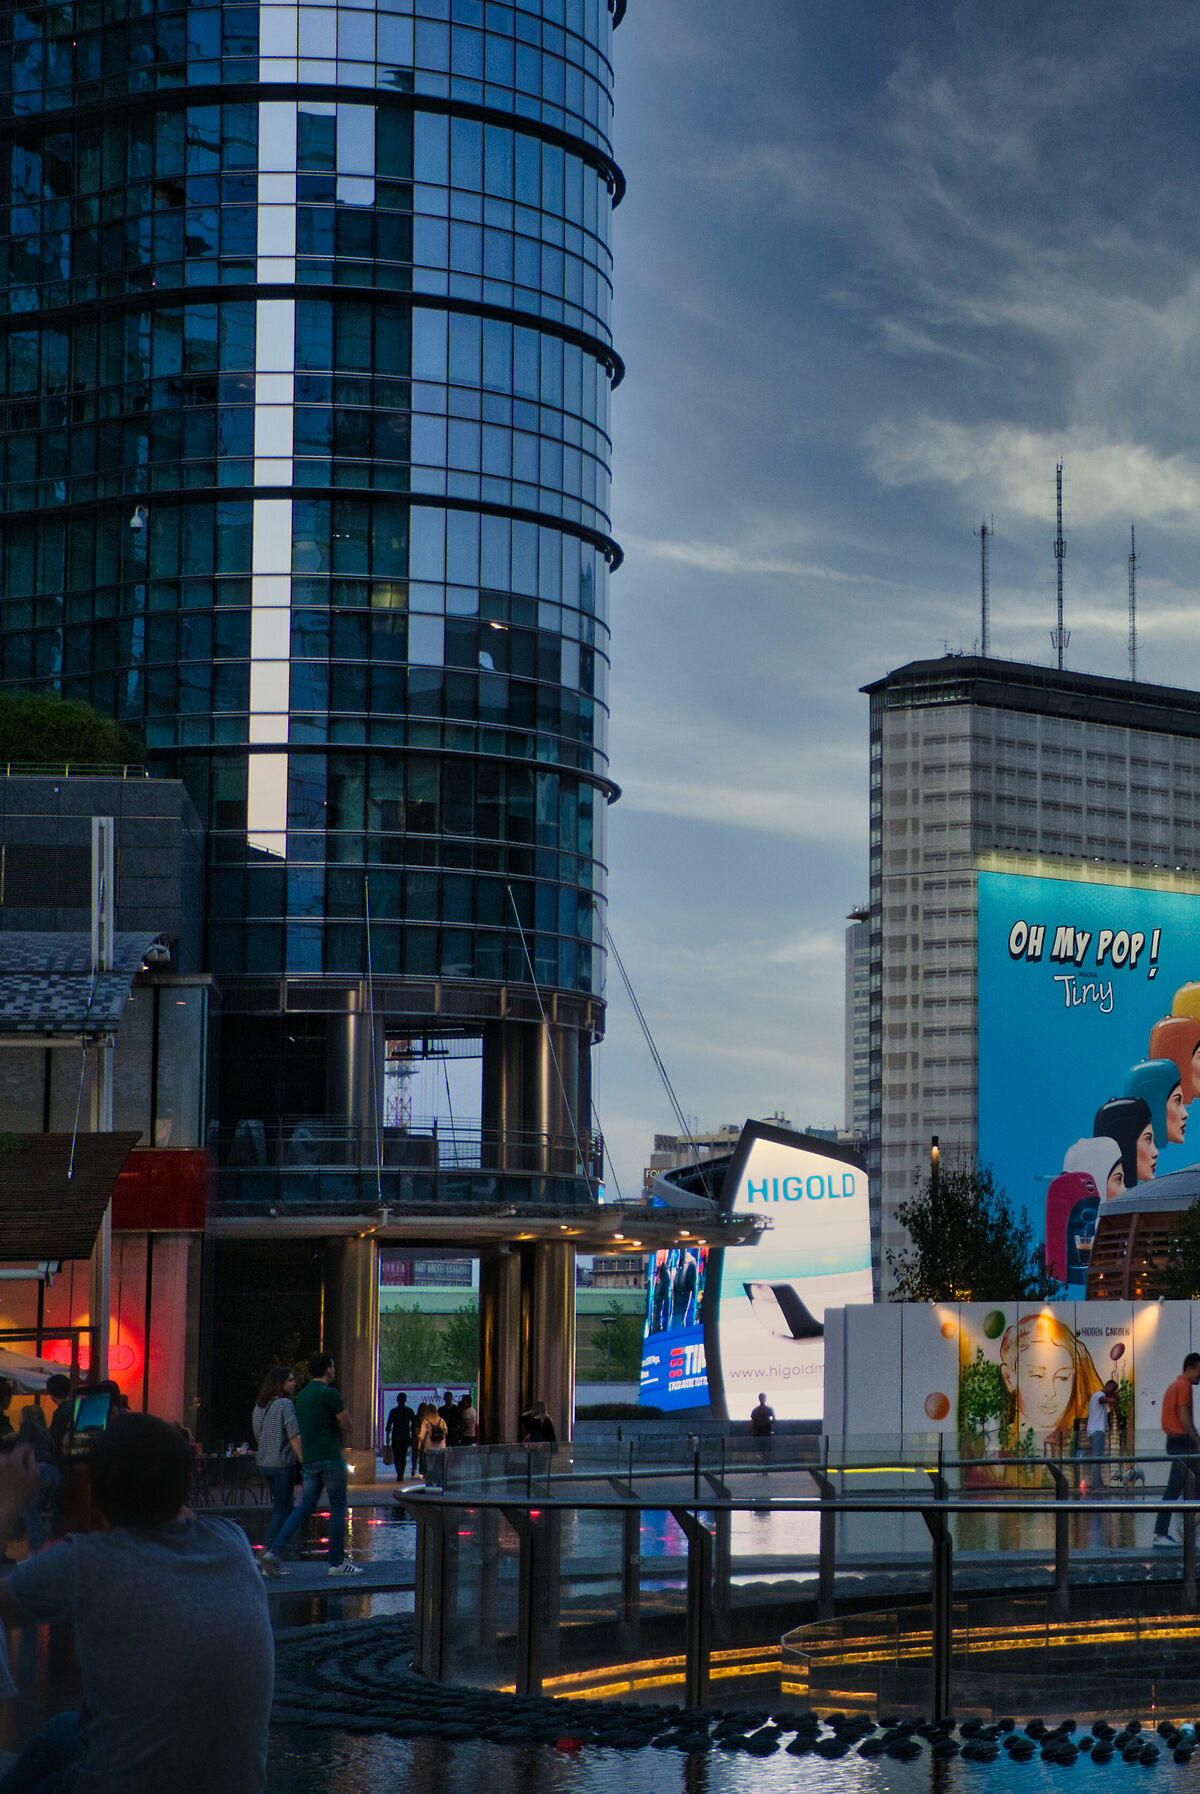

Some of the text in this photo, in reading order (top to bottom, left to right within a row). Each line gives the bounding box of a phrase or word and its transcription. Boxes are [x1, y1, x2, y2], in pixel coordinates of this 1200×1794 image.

[1008, 920, 1046, 963] OH
[1078, 971, 1098, 979] NUOVA
[1053, 974, 1114, 1014] Tiny
[747, 1173, 855, 1203] HIGOLD
[1081, 1326, 1131, 1337] HIDDEN GARDEN
